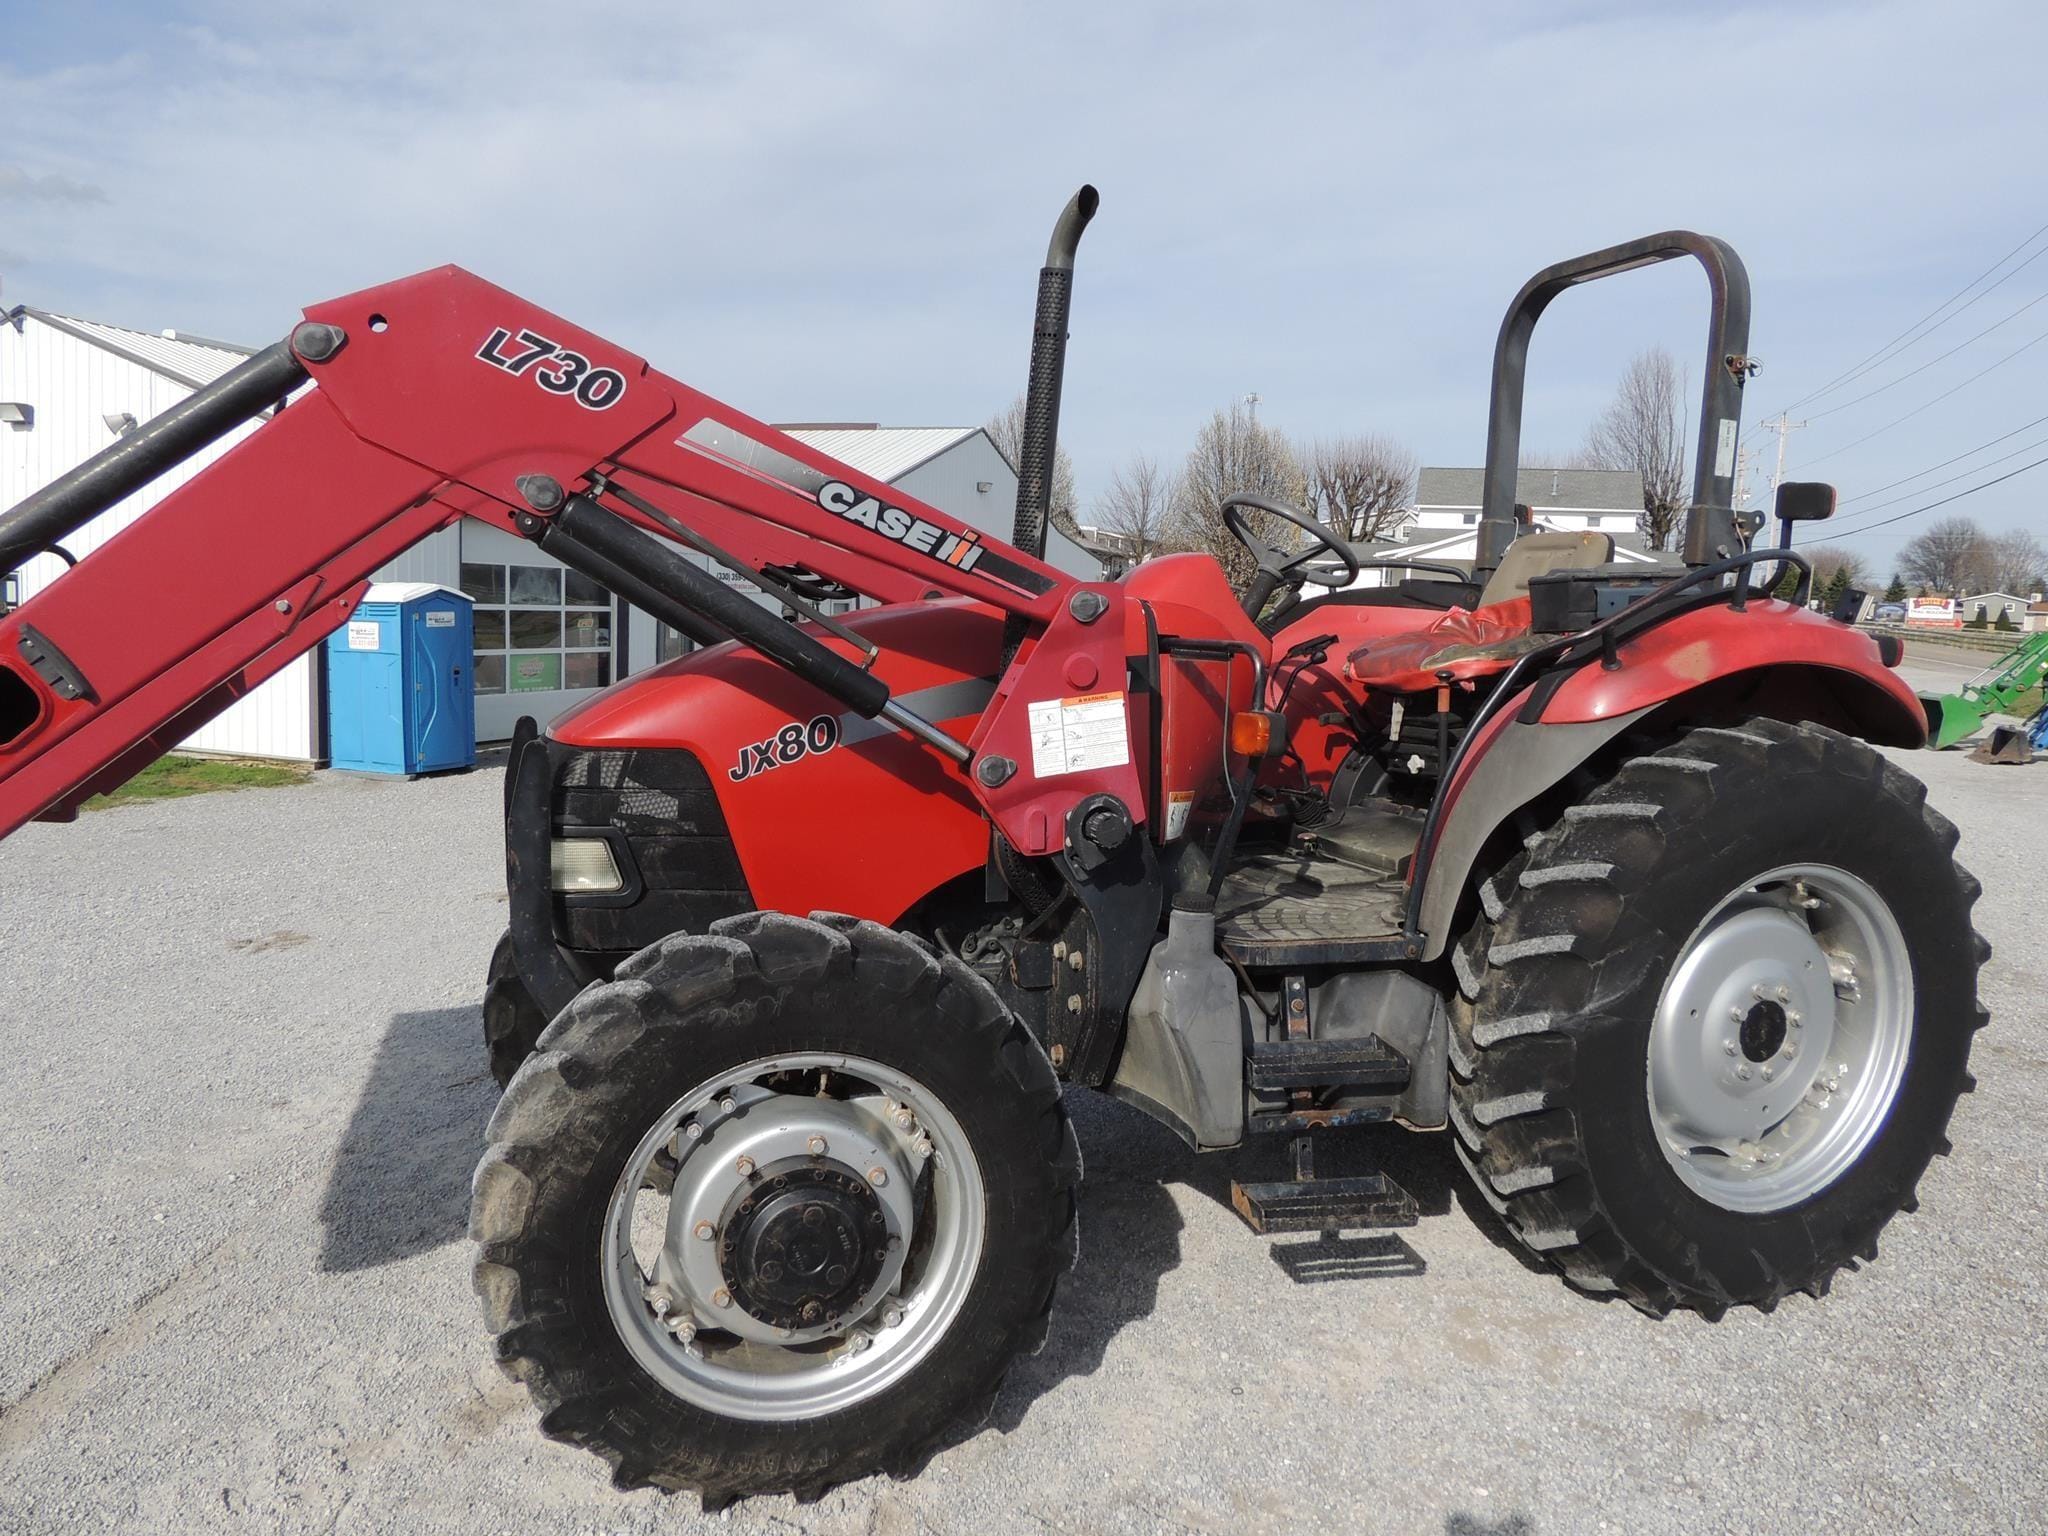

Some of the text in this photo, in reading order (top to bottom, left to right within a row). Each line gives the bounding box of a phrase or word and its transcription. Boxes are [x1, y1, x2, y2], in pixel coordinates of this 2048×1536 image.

[475, 327, 627, 411] L730
[818, 480, 943, 554] CASE
[728, 714, 838, 782] JX80
